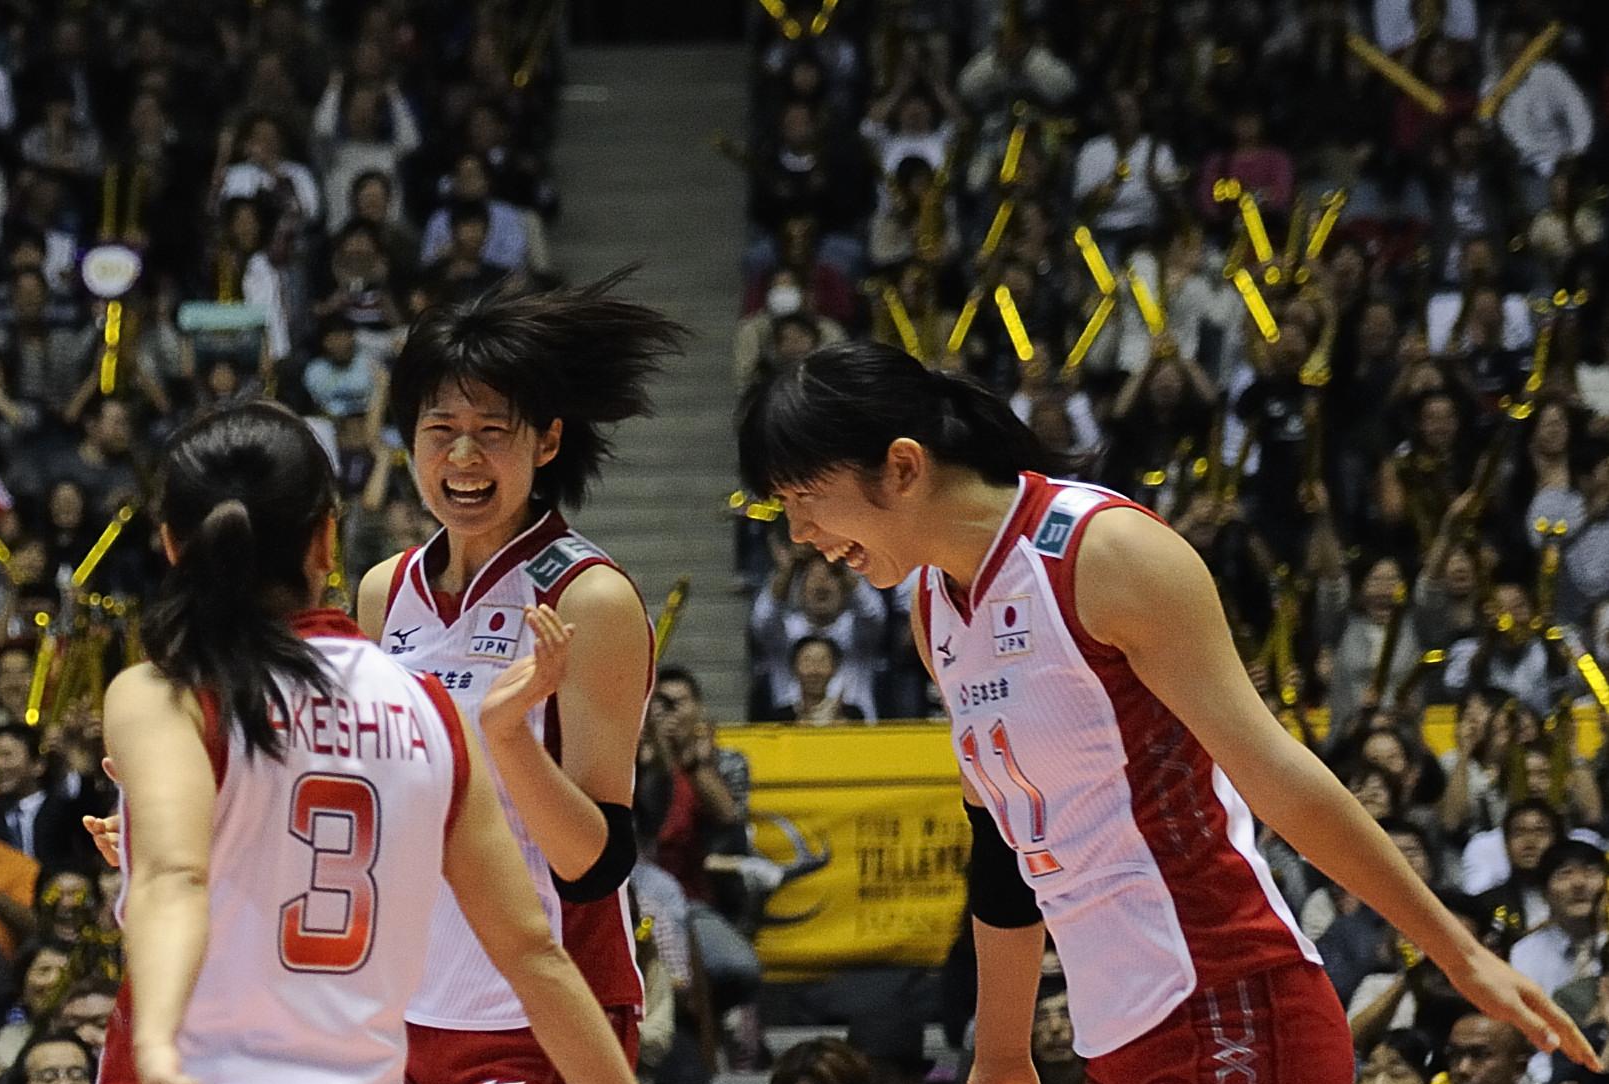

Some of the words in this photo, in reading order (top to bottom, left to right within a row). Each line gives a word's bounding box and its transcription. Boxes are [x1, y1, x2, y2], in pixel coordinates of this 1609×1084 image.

[474, 641, 507, 654] JPN
[999, 636, 1025, 652] JPN
[279, 772, 381, 975] 3
